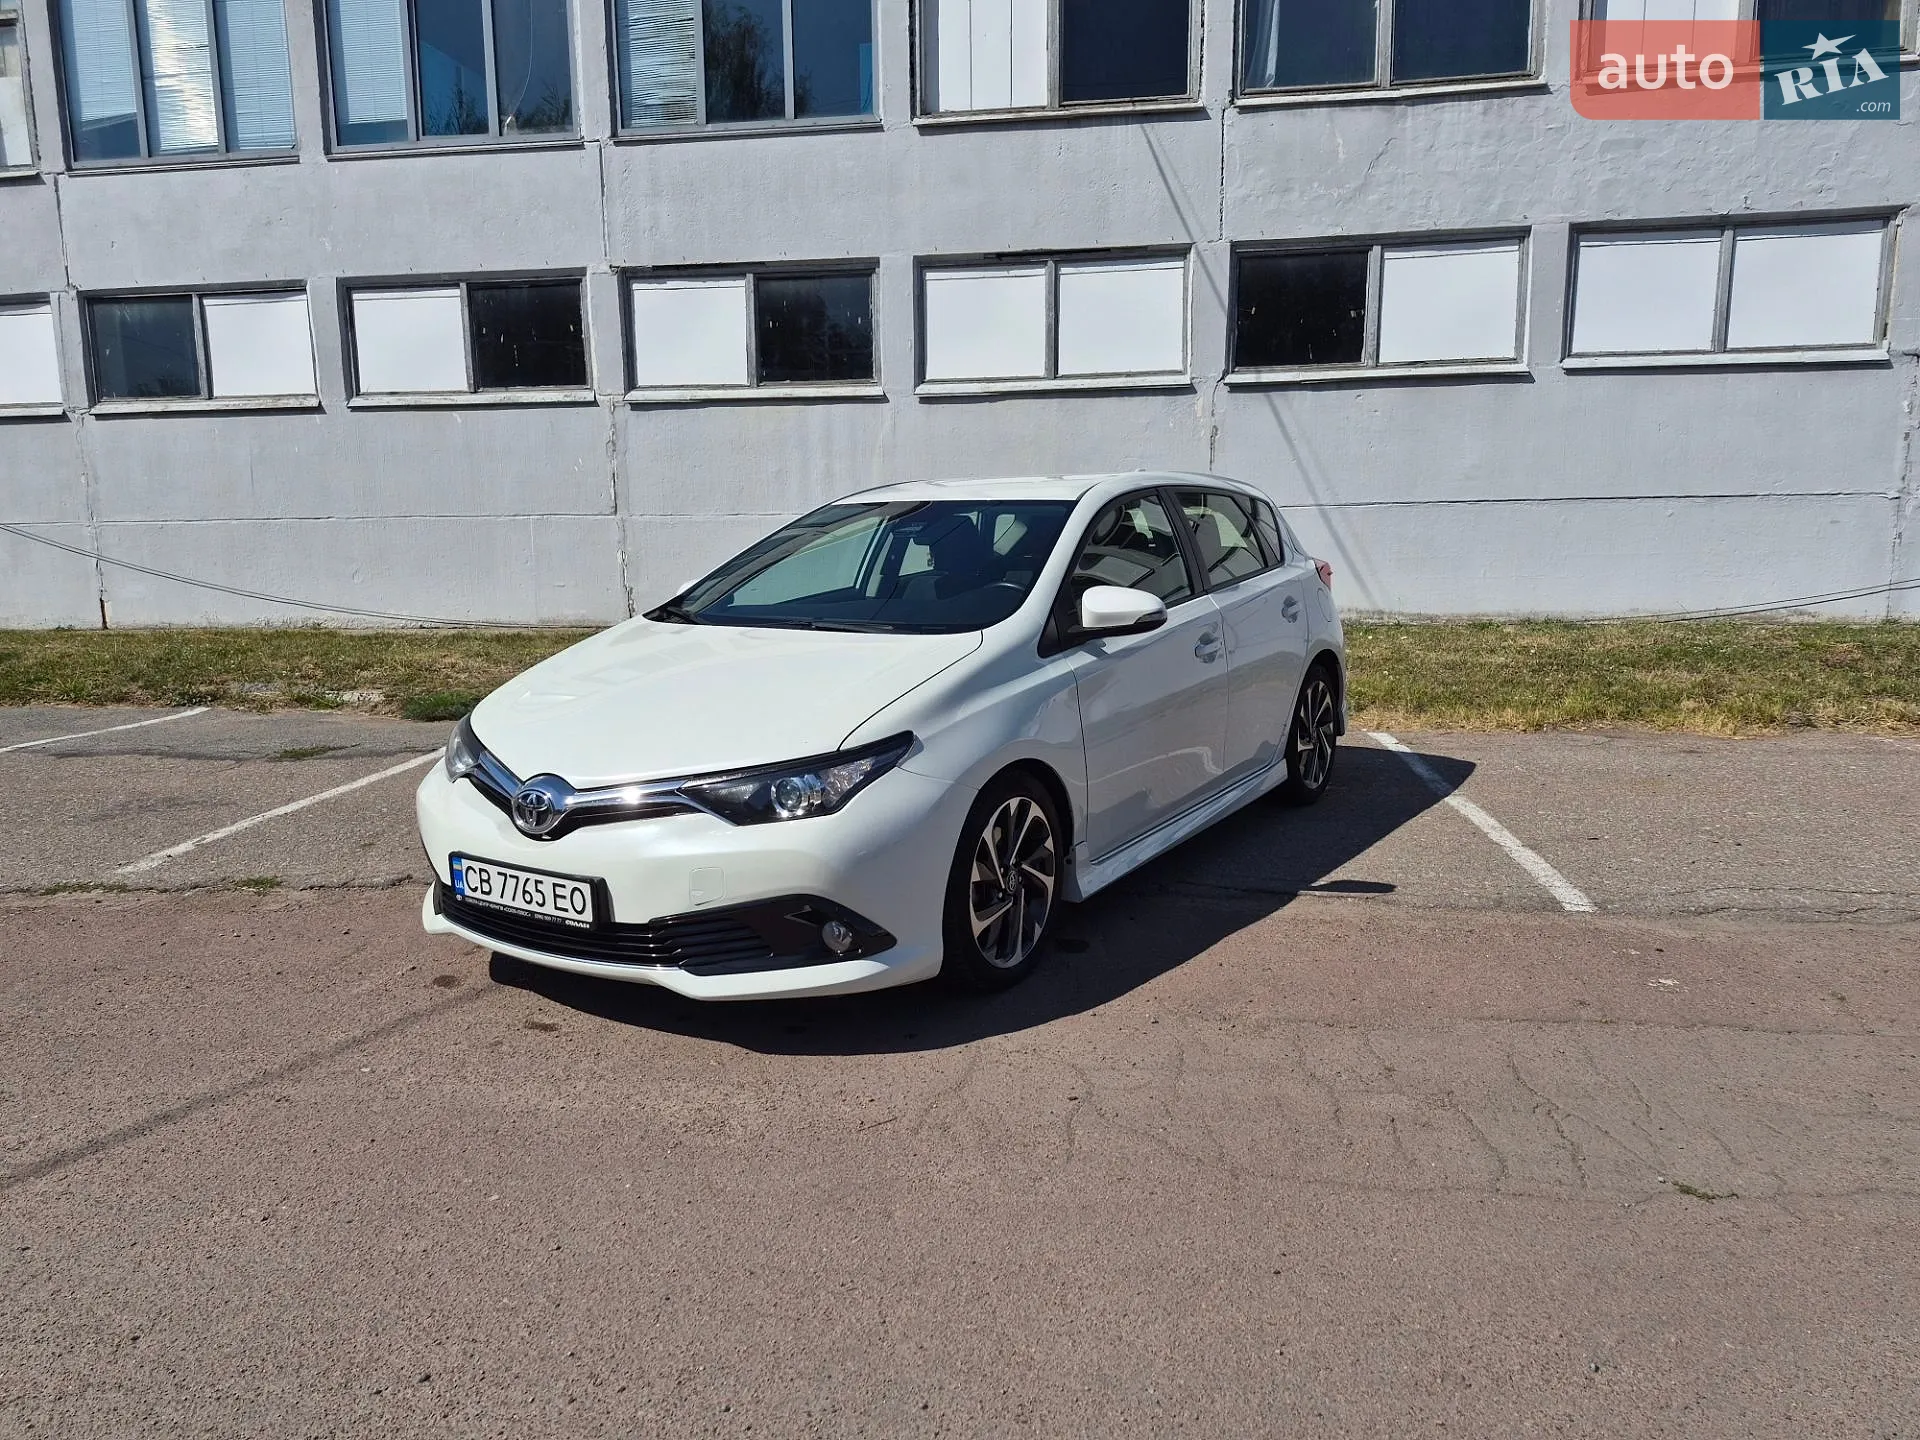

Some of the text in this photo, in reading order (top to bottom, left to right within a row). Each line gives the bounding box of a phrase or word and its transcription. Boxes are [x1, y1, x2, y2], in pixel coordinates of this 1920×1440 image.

[455, 879, 464, 889] UA
[465, 865, 492, 895] CB
[497, 872, 546, 907] 7765
[552, 882, 586, 915] EO
